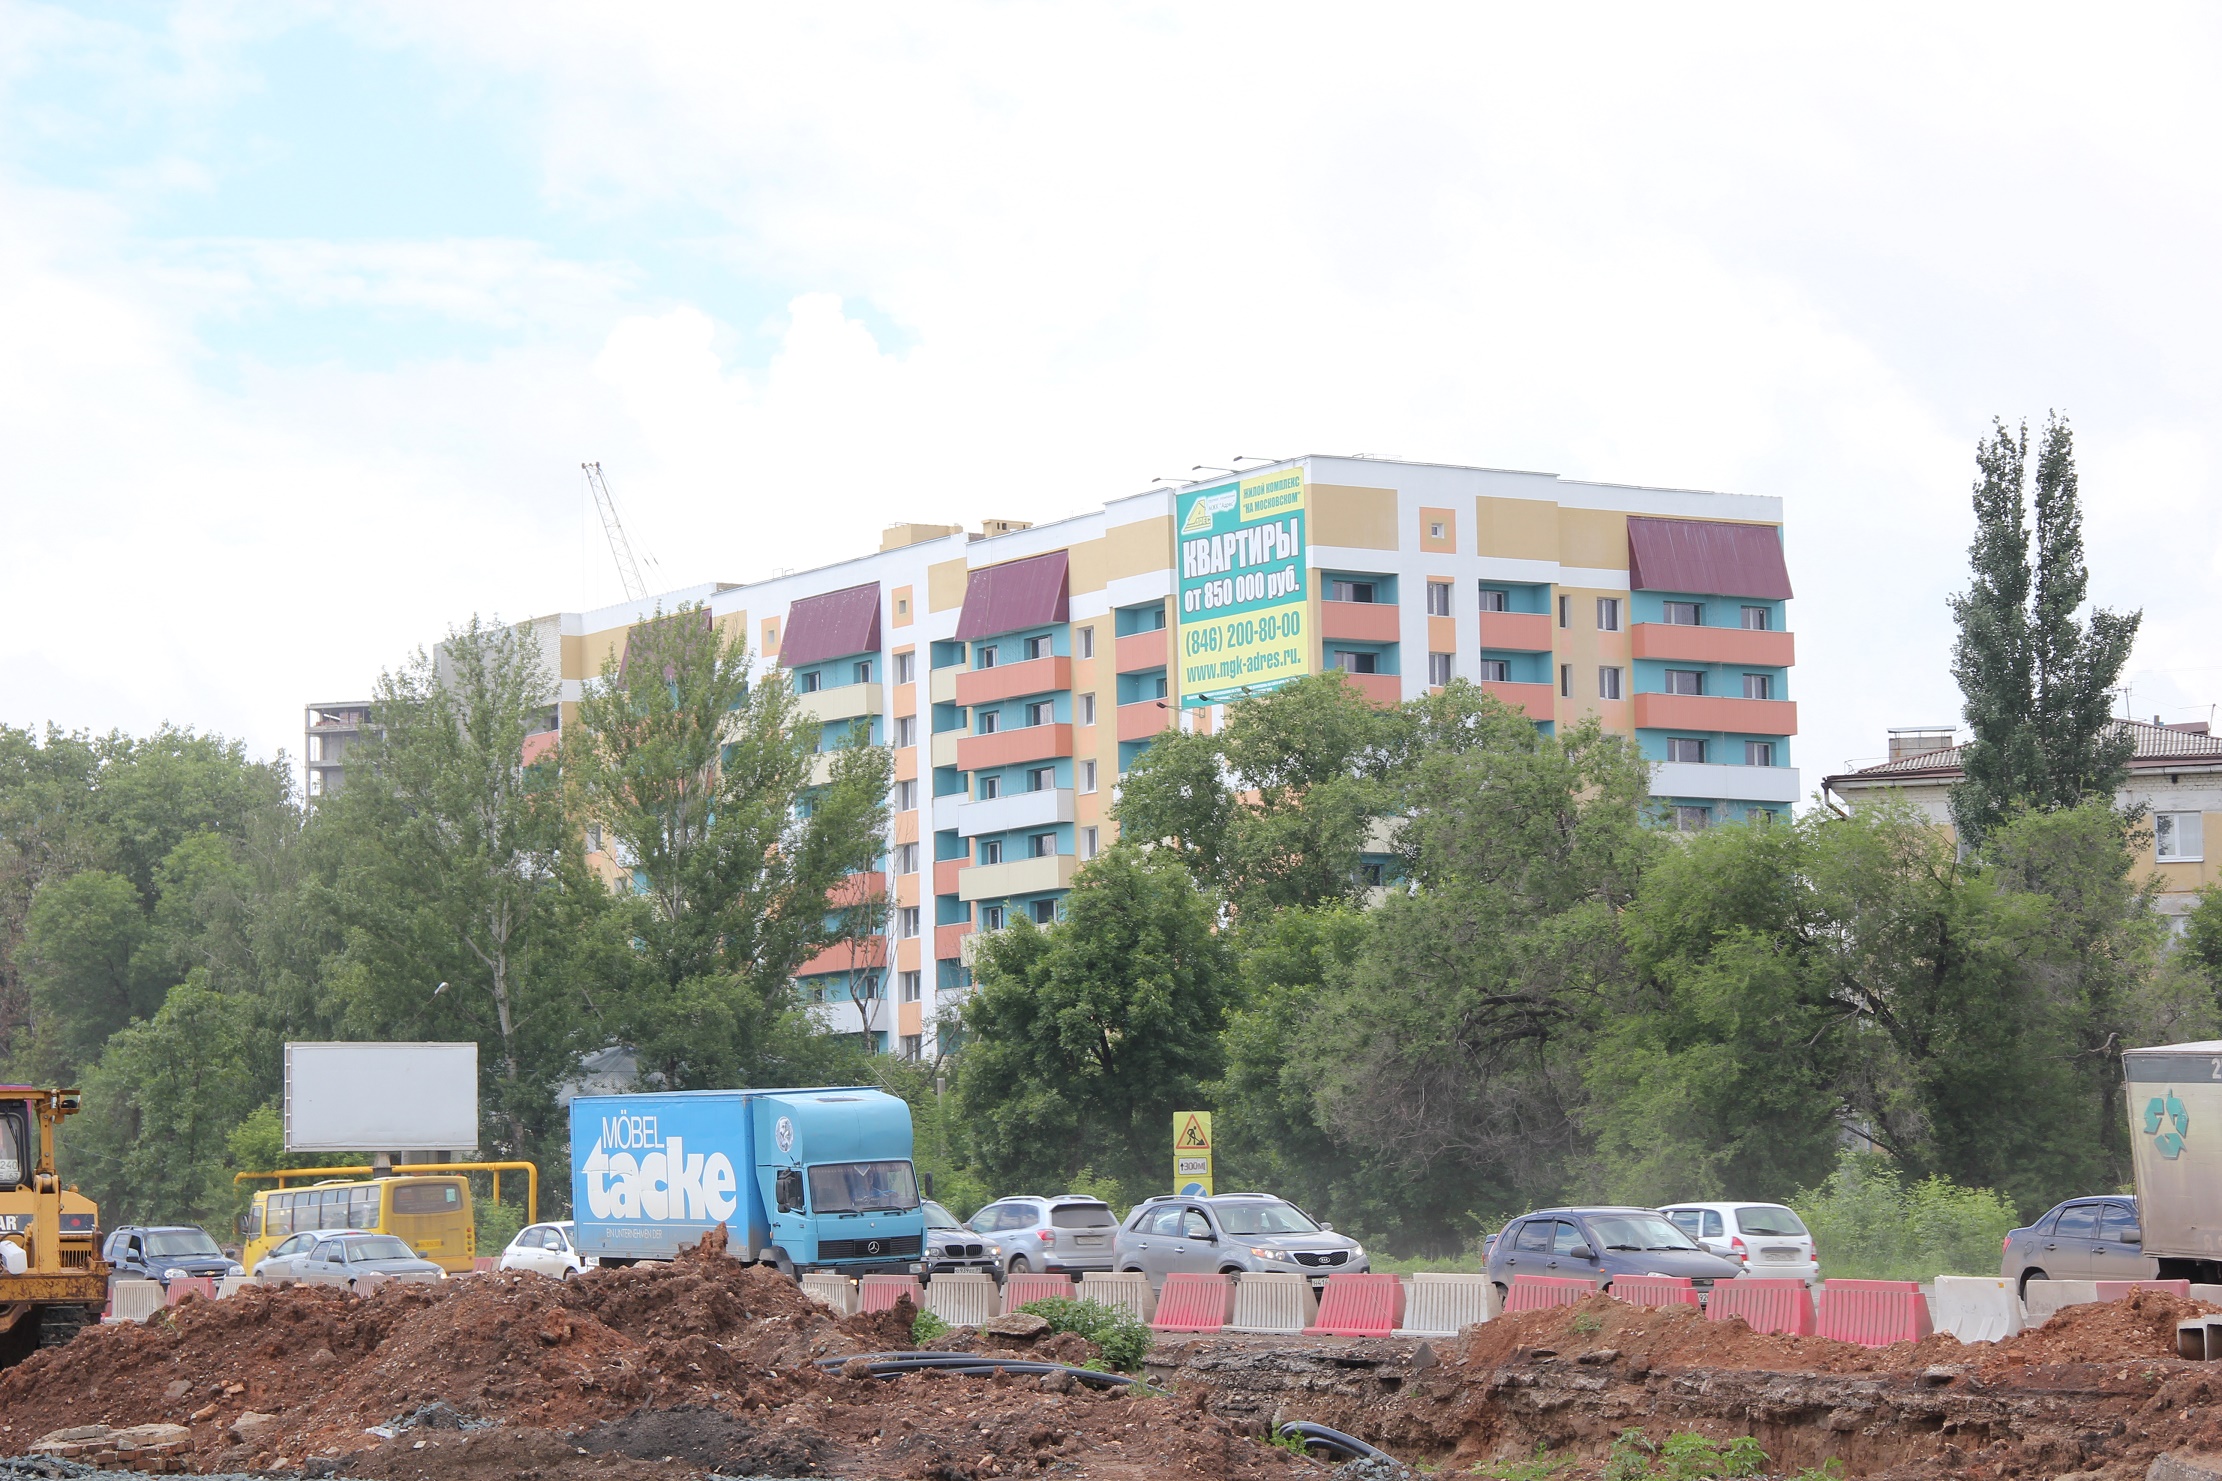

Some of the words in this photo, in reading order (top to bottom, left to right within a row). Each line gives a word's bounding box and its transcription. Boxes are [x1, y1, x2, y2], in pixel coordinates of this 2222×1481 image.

[1243, 482, 1265, 499] ЖИЛОЙ
[1265, 475, 1300, 494] КОМПЛЕКС
[1182, 517, 1299, 579] КВАРТИРЫ
[1204, 578, 1233, 610] 850
[1235, 571, 1265, 603] 000
[1267, 564, 1300, 600] руб.
[1186, 625, 1223, 657] (846)
[1227, 610, 1300, 648] 200-80-00
[1186, 647, 1302, 683] www.mgk-adres.ru.
[2211, 1057, 2222, 1080] 2
[602, 1109, 665, 1149] MÖBEL
[8, 1172, 18, 1180] 63
[581, 1136, 737, 1222] tacke
[1698, 1293, 1709, 1302] 92
